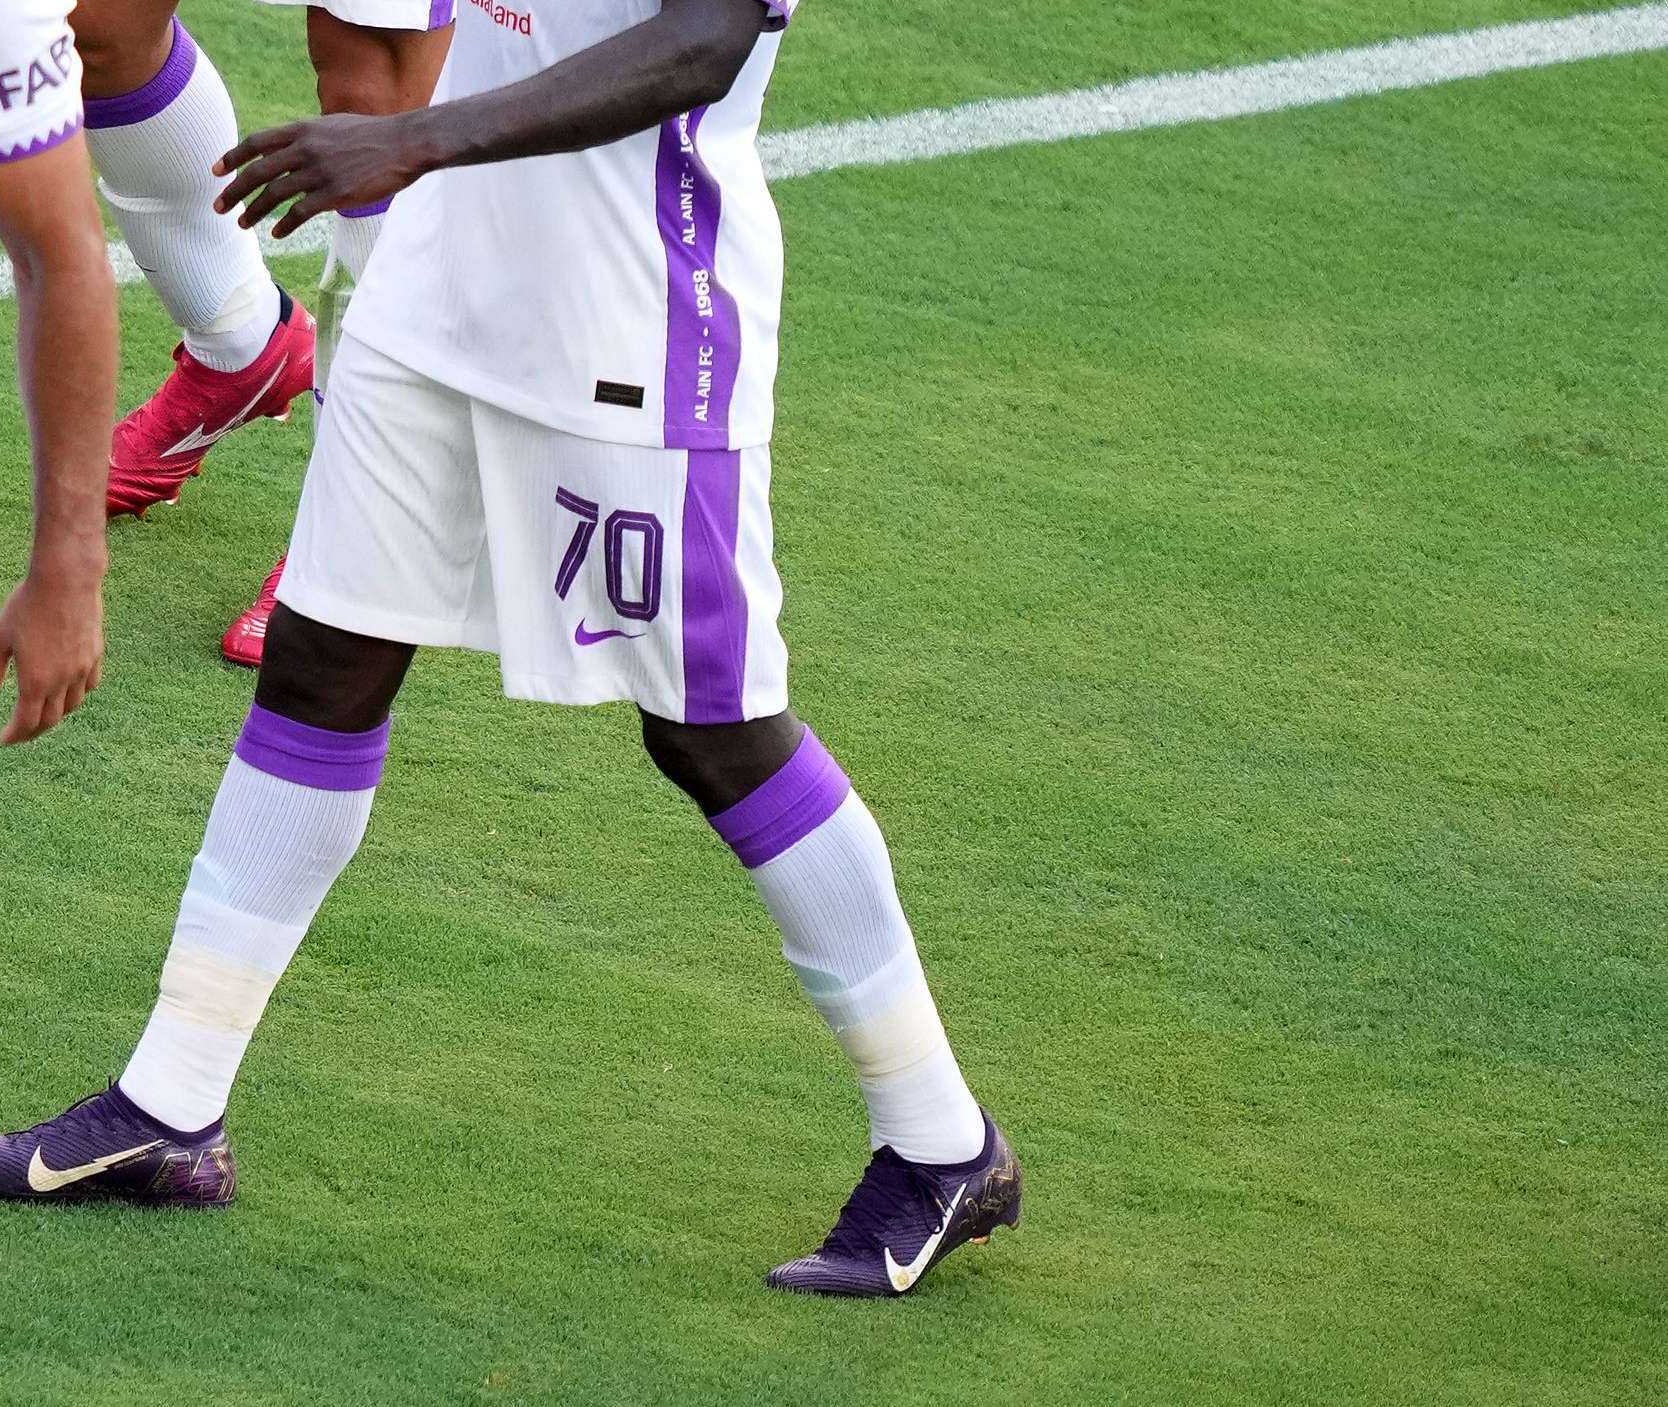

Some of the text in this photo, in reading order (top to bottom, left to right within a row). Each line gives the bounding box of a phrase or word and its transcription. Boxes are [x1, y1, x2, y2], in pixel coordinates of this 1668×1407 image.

[494, 5, 531, 35] and
[680, 193, 694, 220] AIN
[682, 222, 696, 246] AL
[692, 269, 713, 318] 1968
[698, 345, 713, 367] FC
[697, 371, 712, 399] AIN
[694, 399, 709, 423] AL
[554, 486, 664, 623] 70
